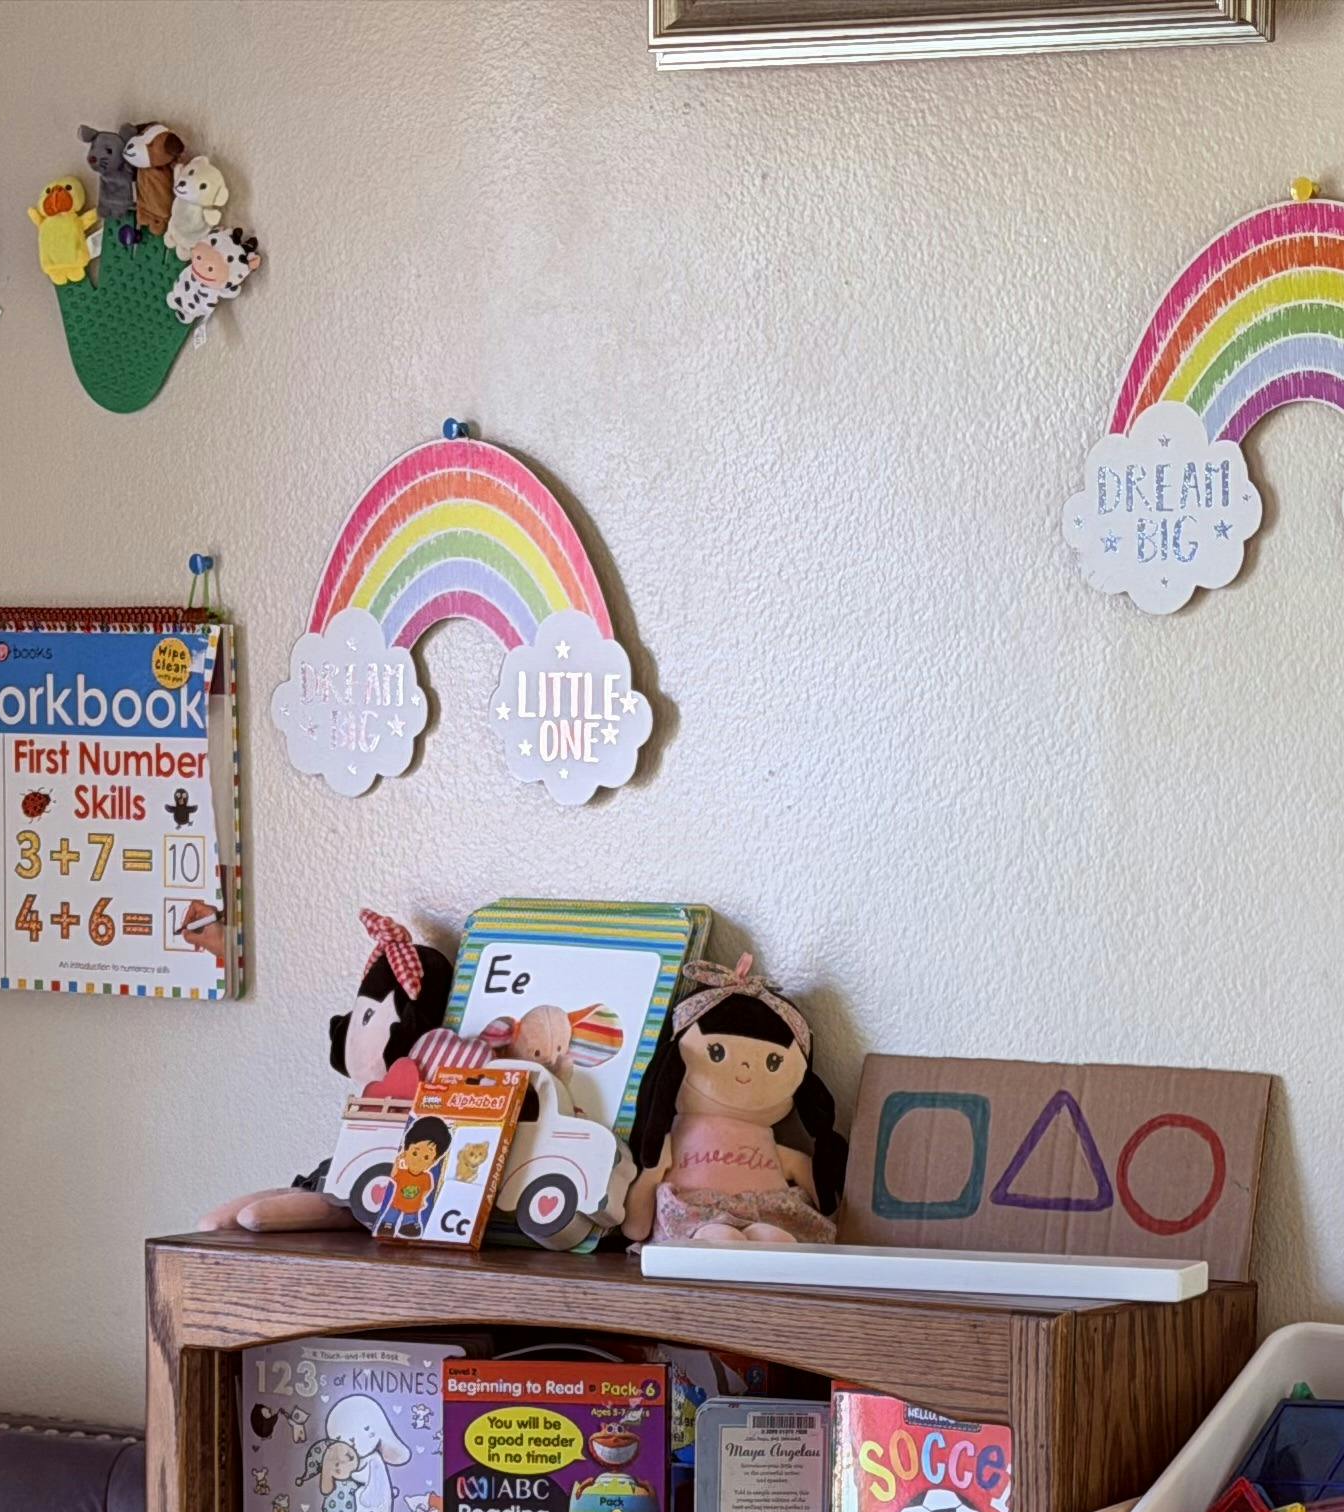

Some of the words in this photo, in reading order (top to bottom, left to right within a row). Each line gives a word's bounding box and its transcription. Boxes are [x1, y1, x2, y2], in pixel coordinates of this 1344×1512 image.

[1097, 459, 1230, 514] DREAM
[1136, 515, 1199, 564] BIG
[158, 645, 186, 662] Wipe
[300, 661, 405, 707] DREAM
[518, 670, 621, 720] LITTLE
[329, 709, 380, 753] BIG
[539, 720, 599, 763] ONE
[14, 739, 70, 775] First
[78, 742, 208, 778] Number
[74, 785, 146, 821] Skills
[169, 842, 200, 882] 10
[484, 954, 531, 994] Ee
[502, 1072, 520, 1086] 36
[448, 1093, 506, 1110] Alphabet
[679, 1146, 778, 1170] sweetie
[440, 1209, 470, 1236] Cc
[447, 1379, 522, 1397] Beginning
[526, 1380, 541, 1395] to
[546, 1380, 584, 1395] Read
[601, 1382, 637, 1396] Pack
[645, 1382, 655, 1397] 6
[487, 1416, 512, 1429] You
[517, 1416, 540, 1429] will
[544, 1417, 562, 1430] be
[474, 1436, 484, 1446] a
[488, 1434, 524, 1449] good
[528, 1435, 576, 1447] reader
[725, 1443, 767, 1461] Maya
[487, 1448, 501, 1462] in
[504, 1454, 523, 1463] no
[527, 1452, 562, 1464] time!
[497, 1478, 550, 1500] ABC
[599, 1497, 624, 1507] Pack
